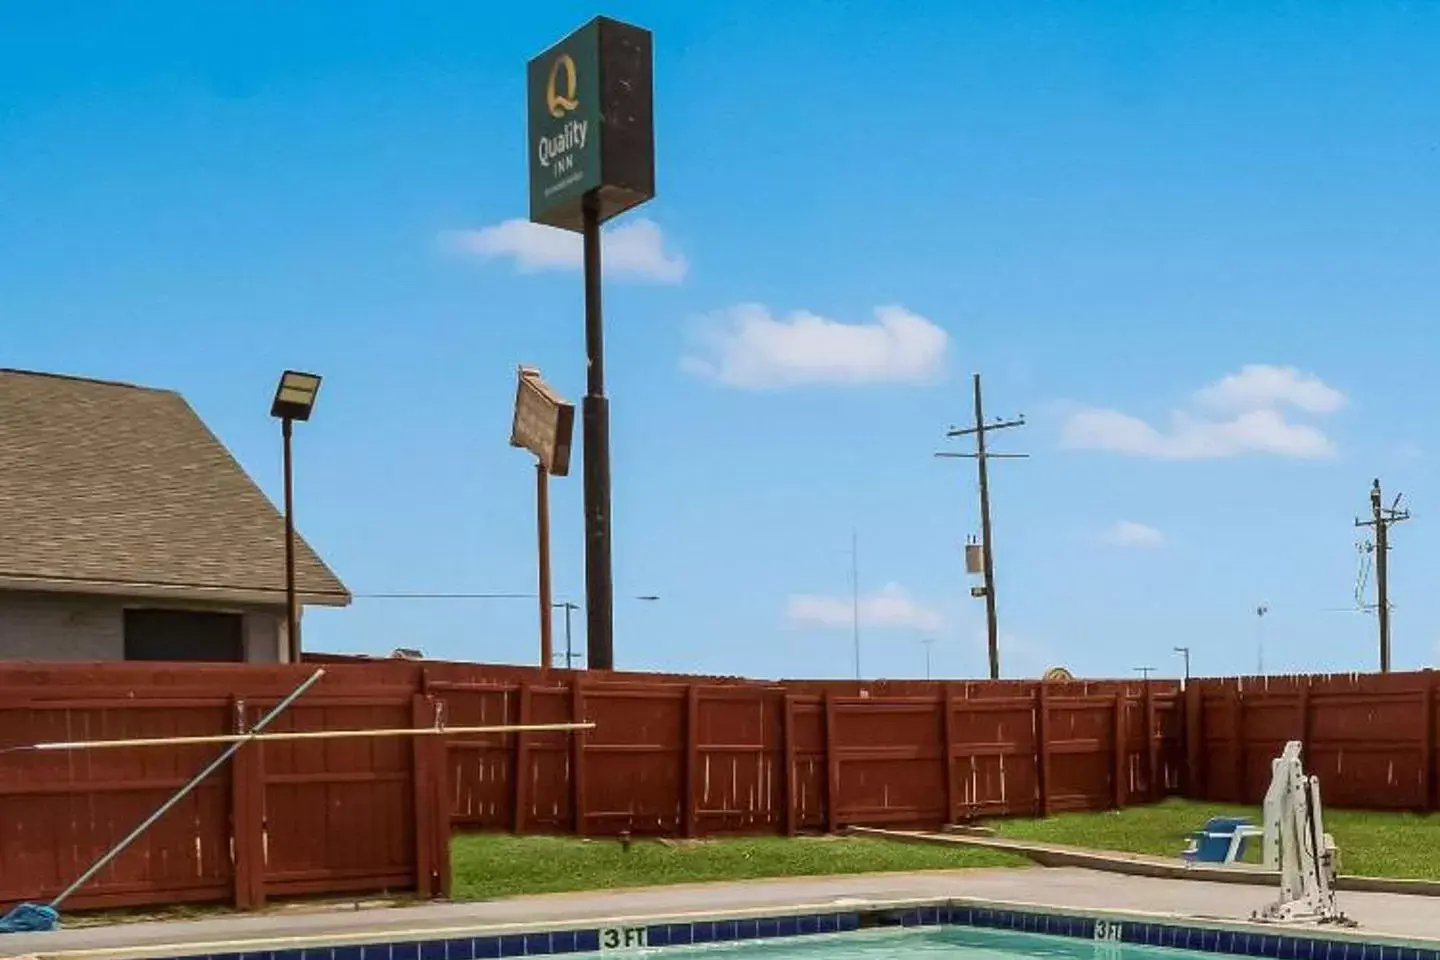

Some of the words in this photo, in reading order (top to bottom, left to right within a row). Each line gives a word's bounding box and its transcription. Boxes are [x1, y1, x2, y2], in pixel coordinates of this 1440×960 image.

[539, 120, 588, 167] Quality
[554, 154, 574, 178] INN
[604, 929, 619, 948] 3
[625, 926, 646, 947] FT
[1097, 921, 1106, 938] 3
